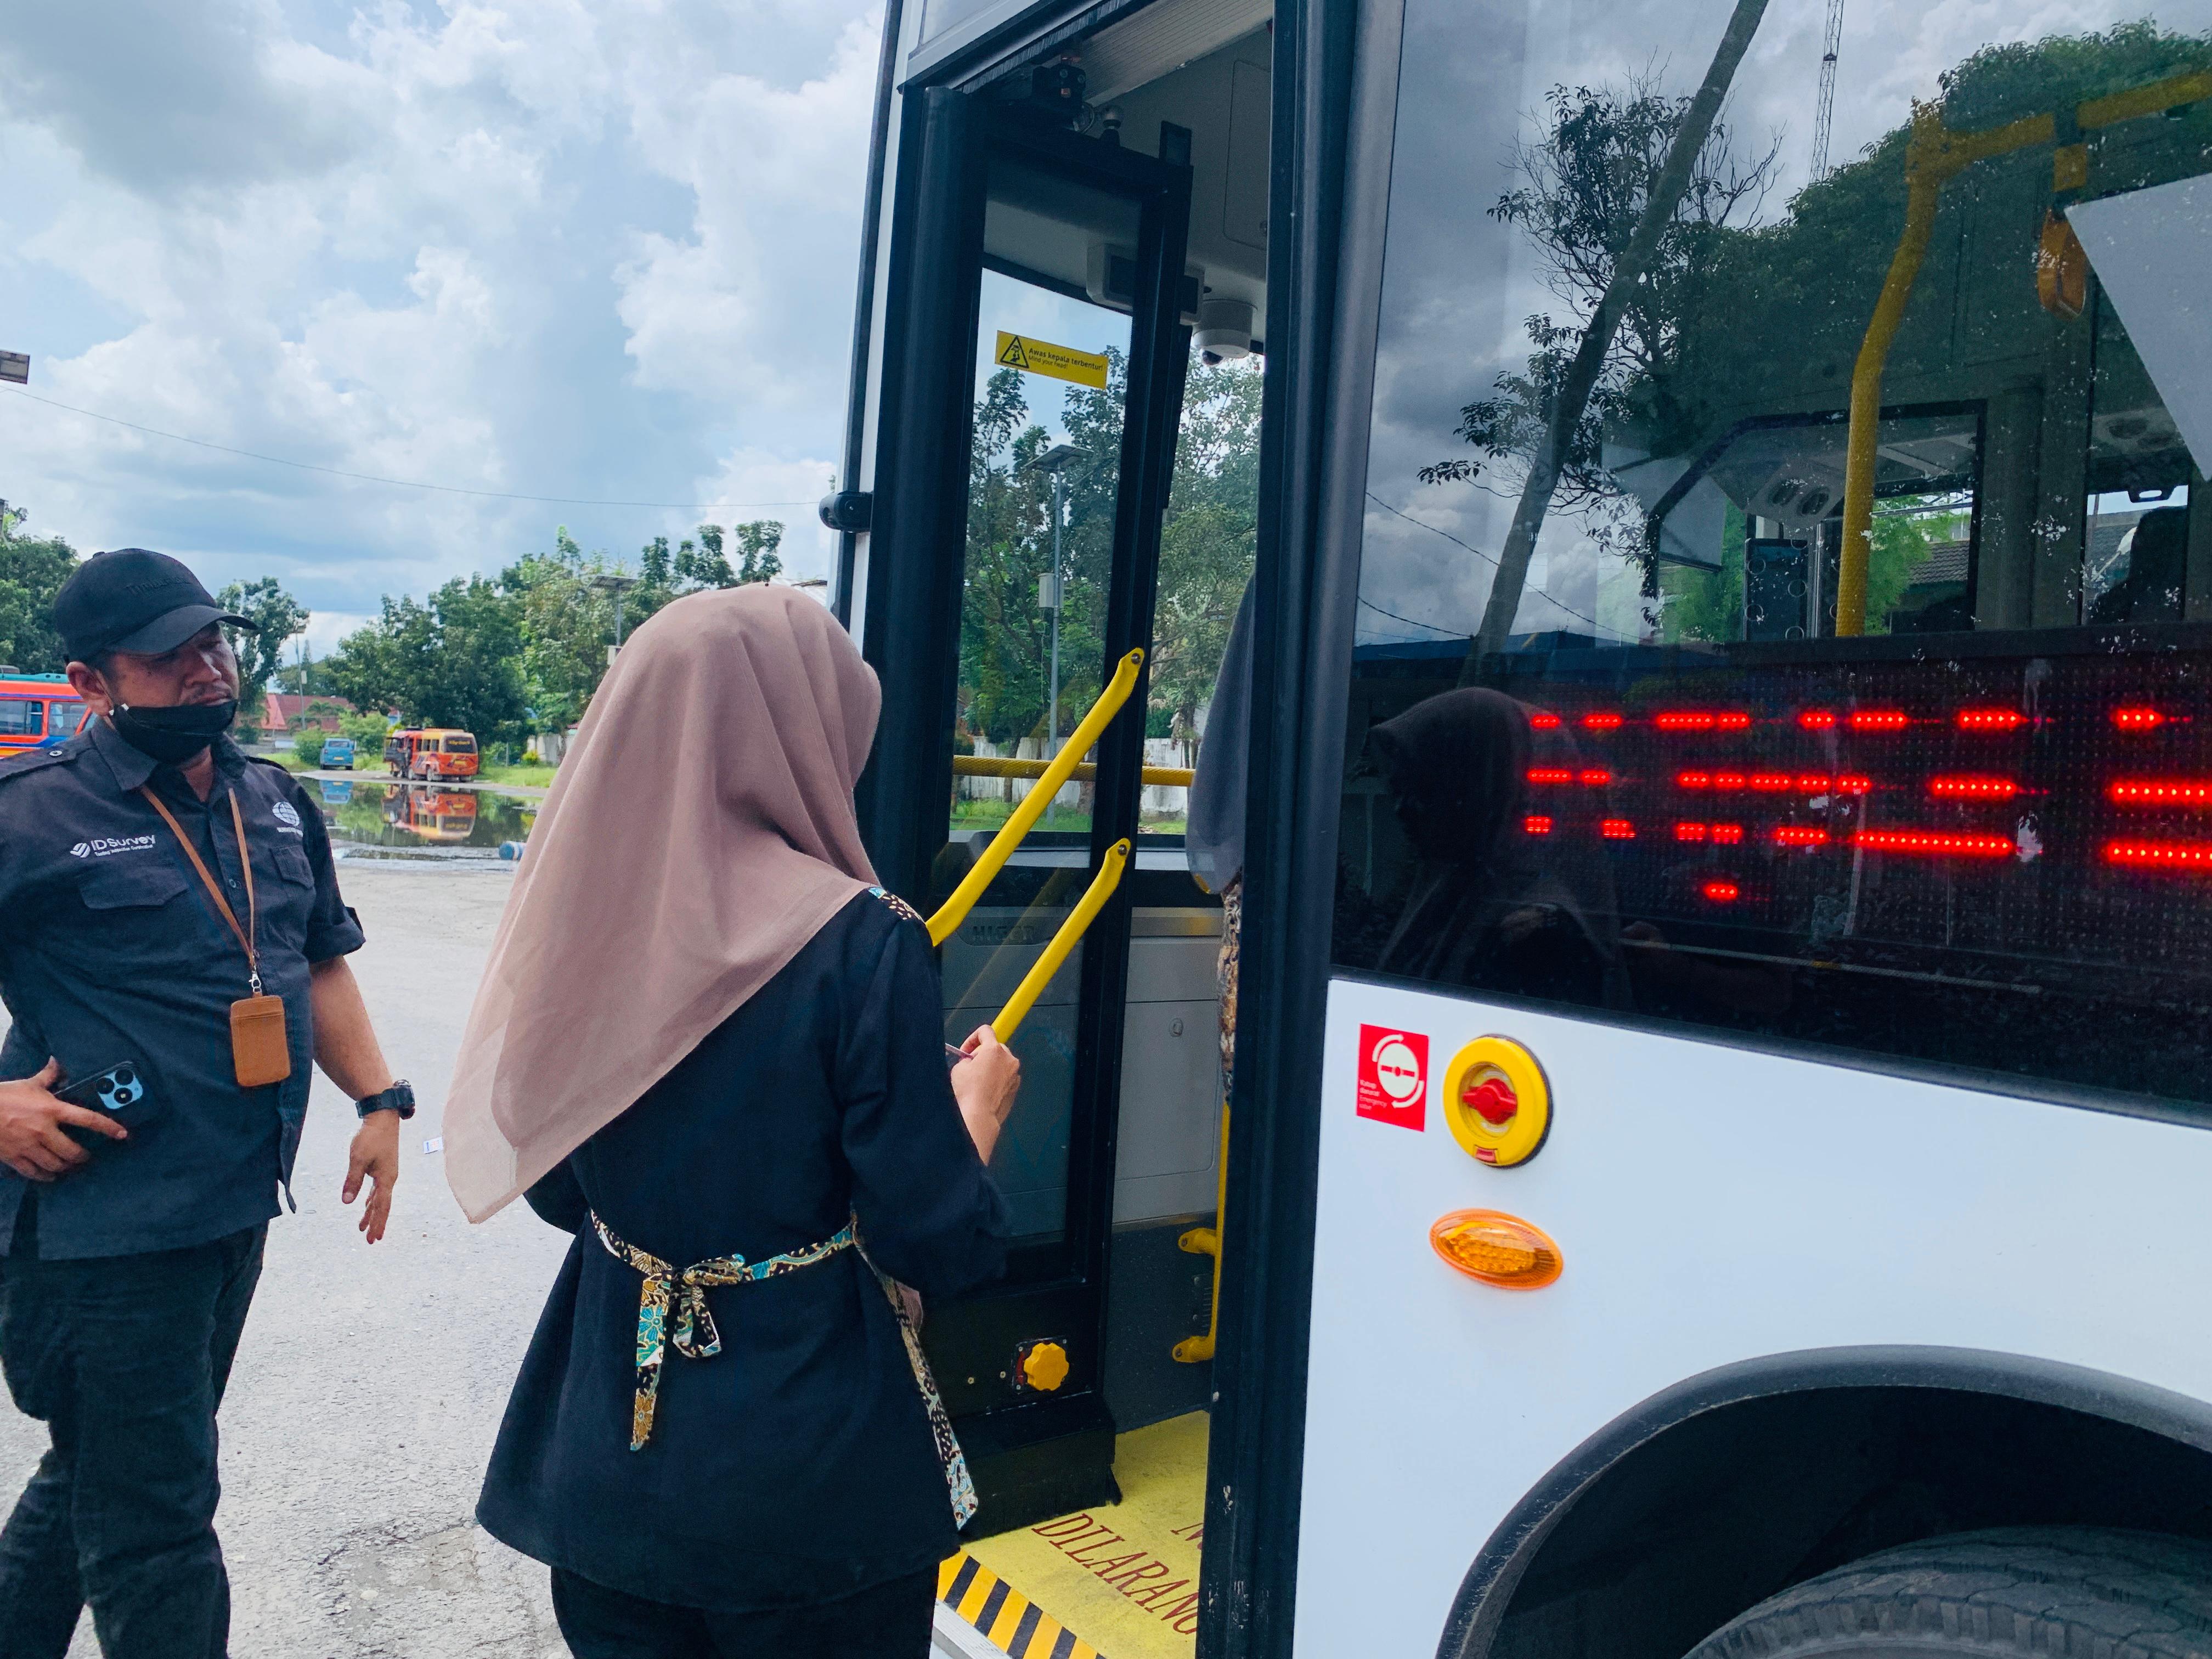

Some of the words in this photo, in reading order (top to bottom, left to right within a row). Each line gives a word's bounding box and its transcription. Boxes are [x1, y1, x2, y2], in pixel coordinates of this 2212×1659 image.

[1029, 348, 1046, 358] Awas
[1048, 352, 1069, 363] kepala
[1071, 358, 1103, 371] terbentur!
